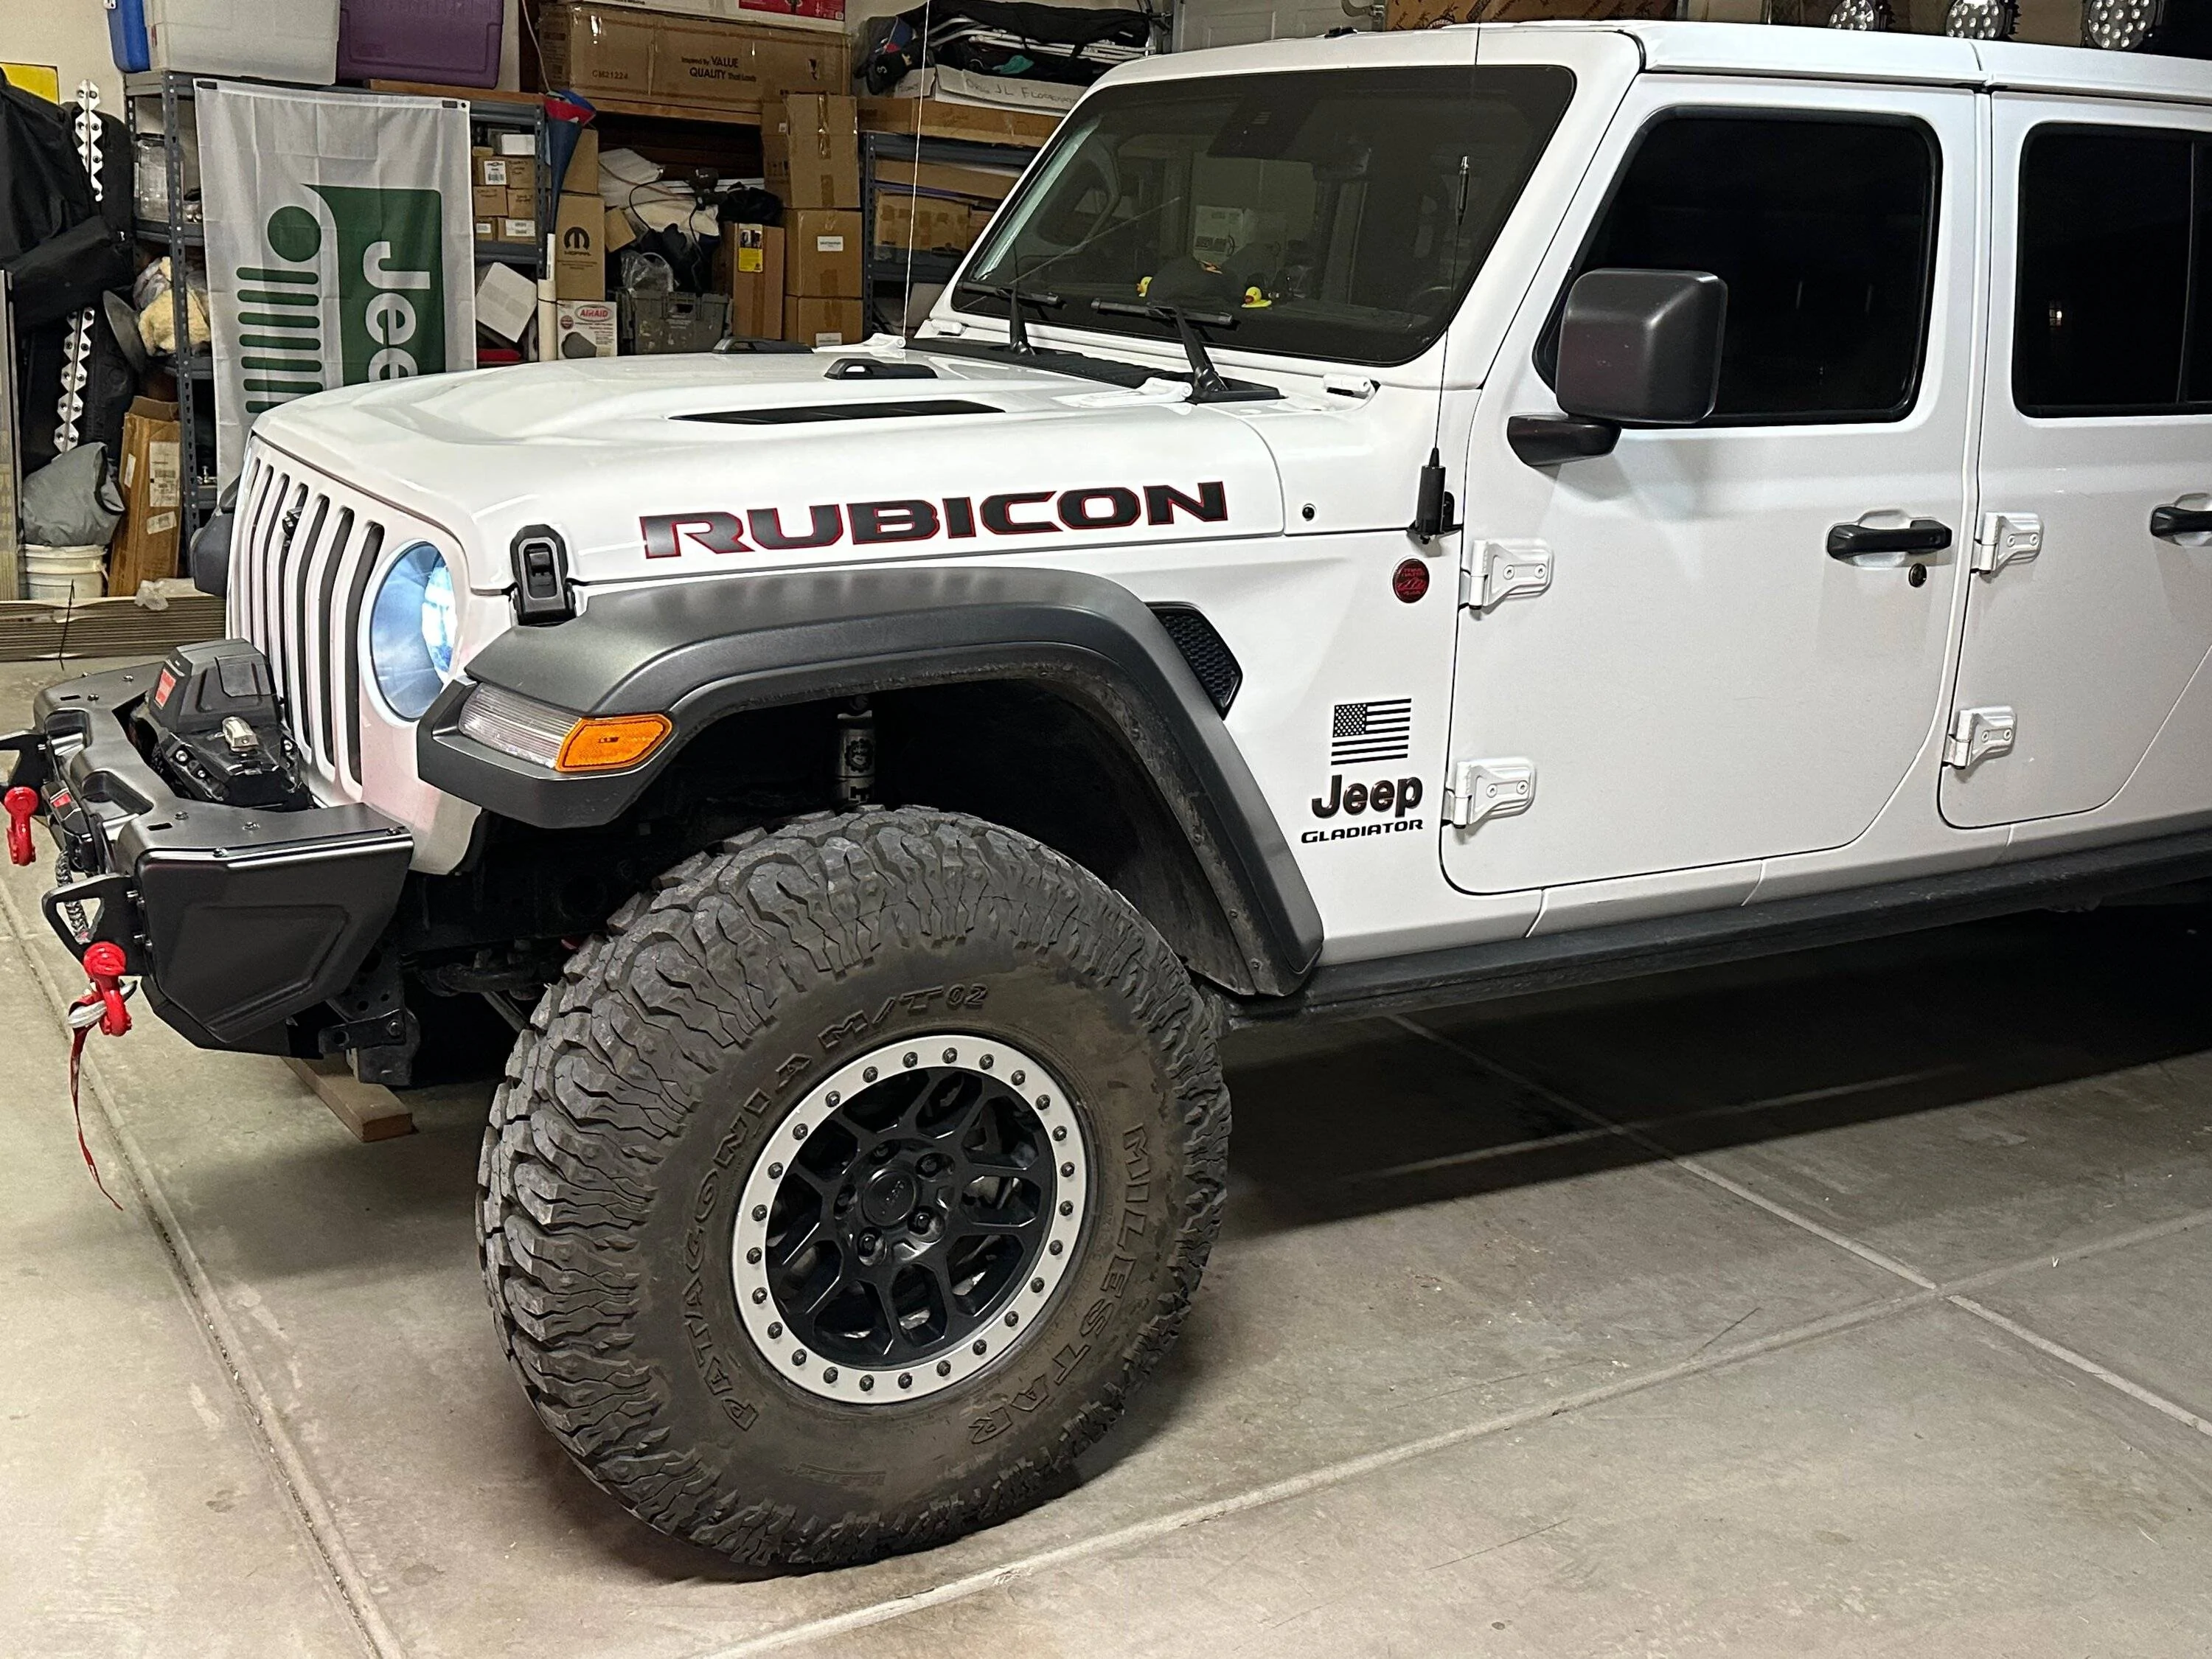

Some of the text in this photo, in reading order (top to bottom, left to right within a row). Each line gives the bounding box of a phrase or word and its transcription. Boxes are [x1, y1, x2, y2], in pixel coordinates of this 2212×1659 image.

[689, 66, 726, 80] QUALITY
[710, 55, 739, 69] VALUE
[363, 240, 431, 383] Jee
[580, 309, 608, 318] AIRAID
[639, 480, 1228, 560] RUBICON
[1311, 773, 1424, 820] Jeep
[1301, 818, 1424, 844] GLADIATOR
[681, 1052, 813, 1432] PATAGONIA
[969, 1122, 1153, 1445] MILESTAR
